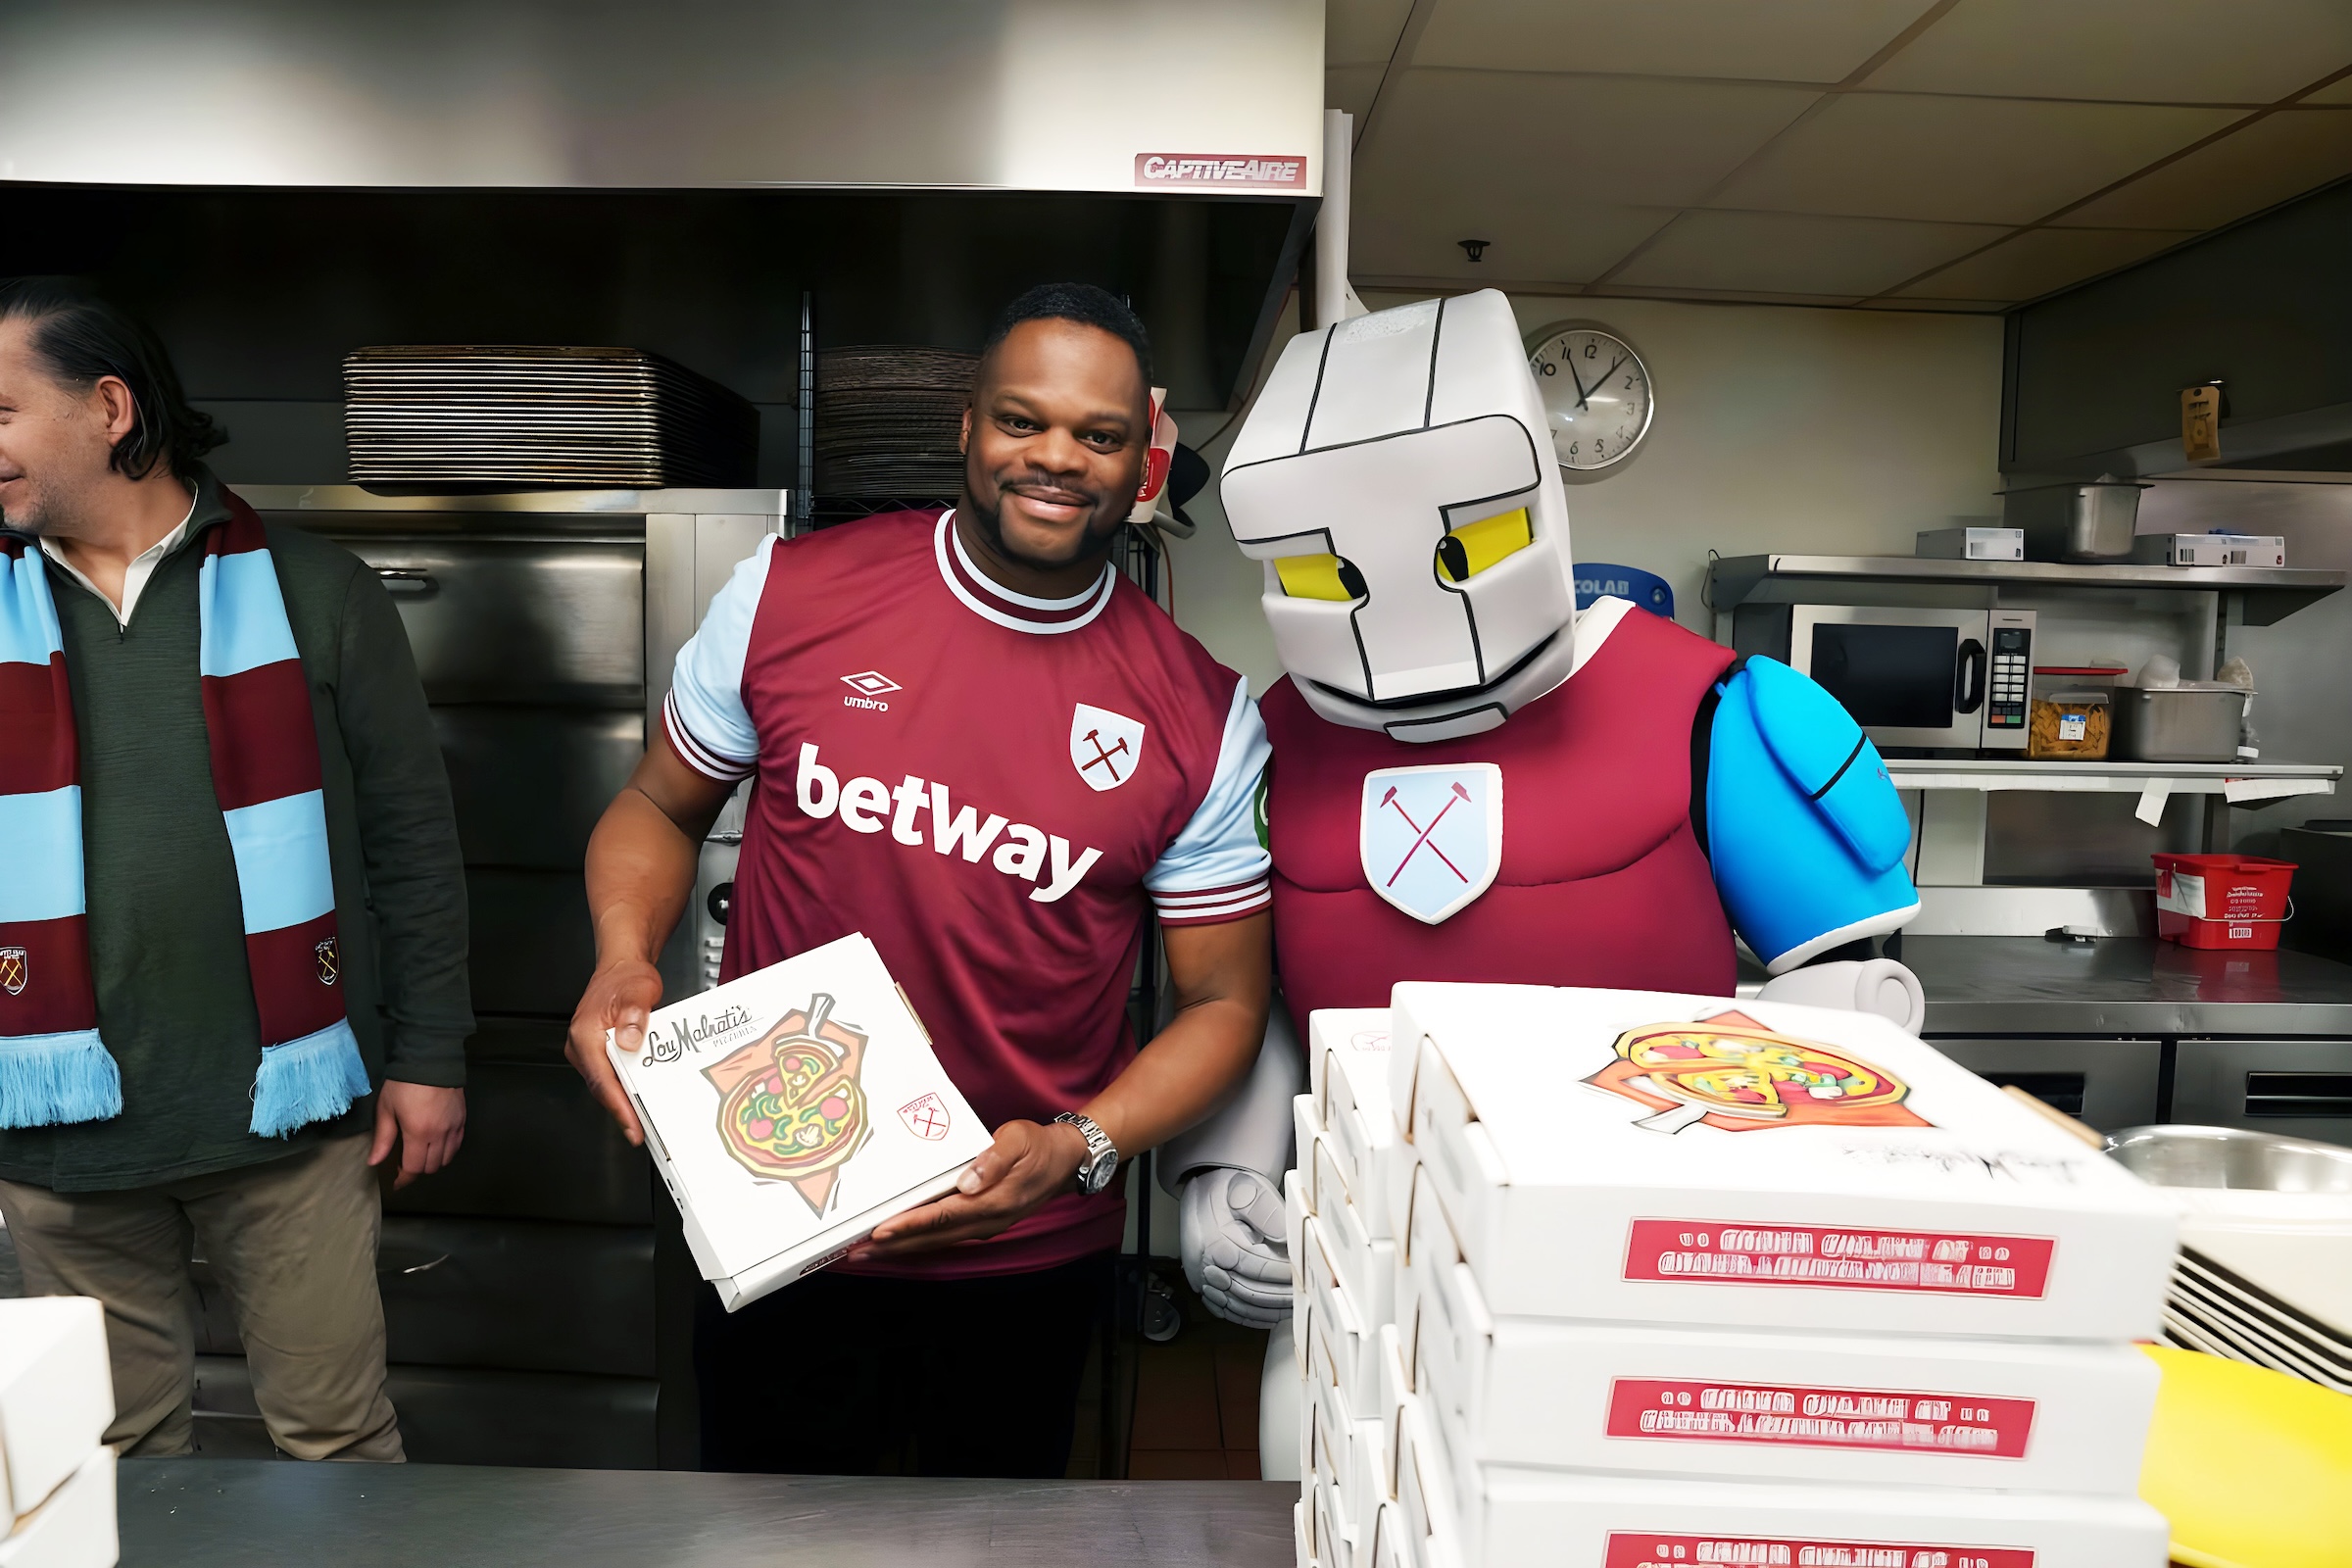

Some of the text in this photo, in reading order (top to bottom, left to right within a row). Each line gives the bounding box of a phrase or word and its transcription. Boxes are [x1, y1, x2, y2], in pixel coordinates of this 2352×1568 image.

[1539, 362, 1556, 376] 10
[1624, 375, 1634, 390] 2
[1569, 441, 1579, 455] 6
[1574, 579, 1629, 595] COLAB
[843, 695, 889, 712] umbro
[796, 742, 1104, 904] betway
[642, 1030, 678, 1067] Lou
